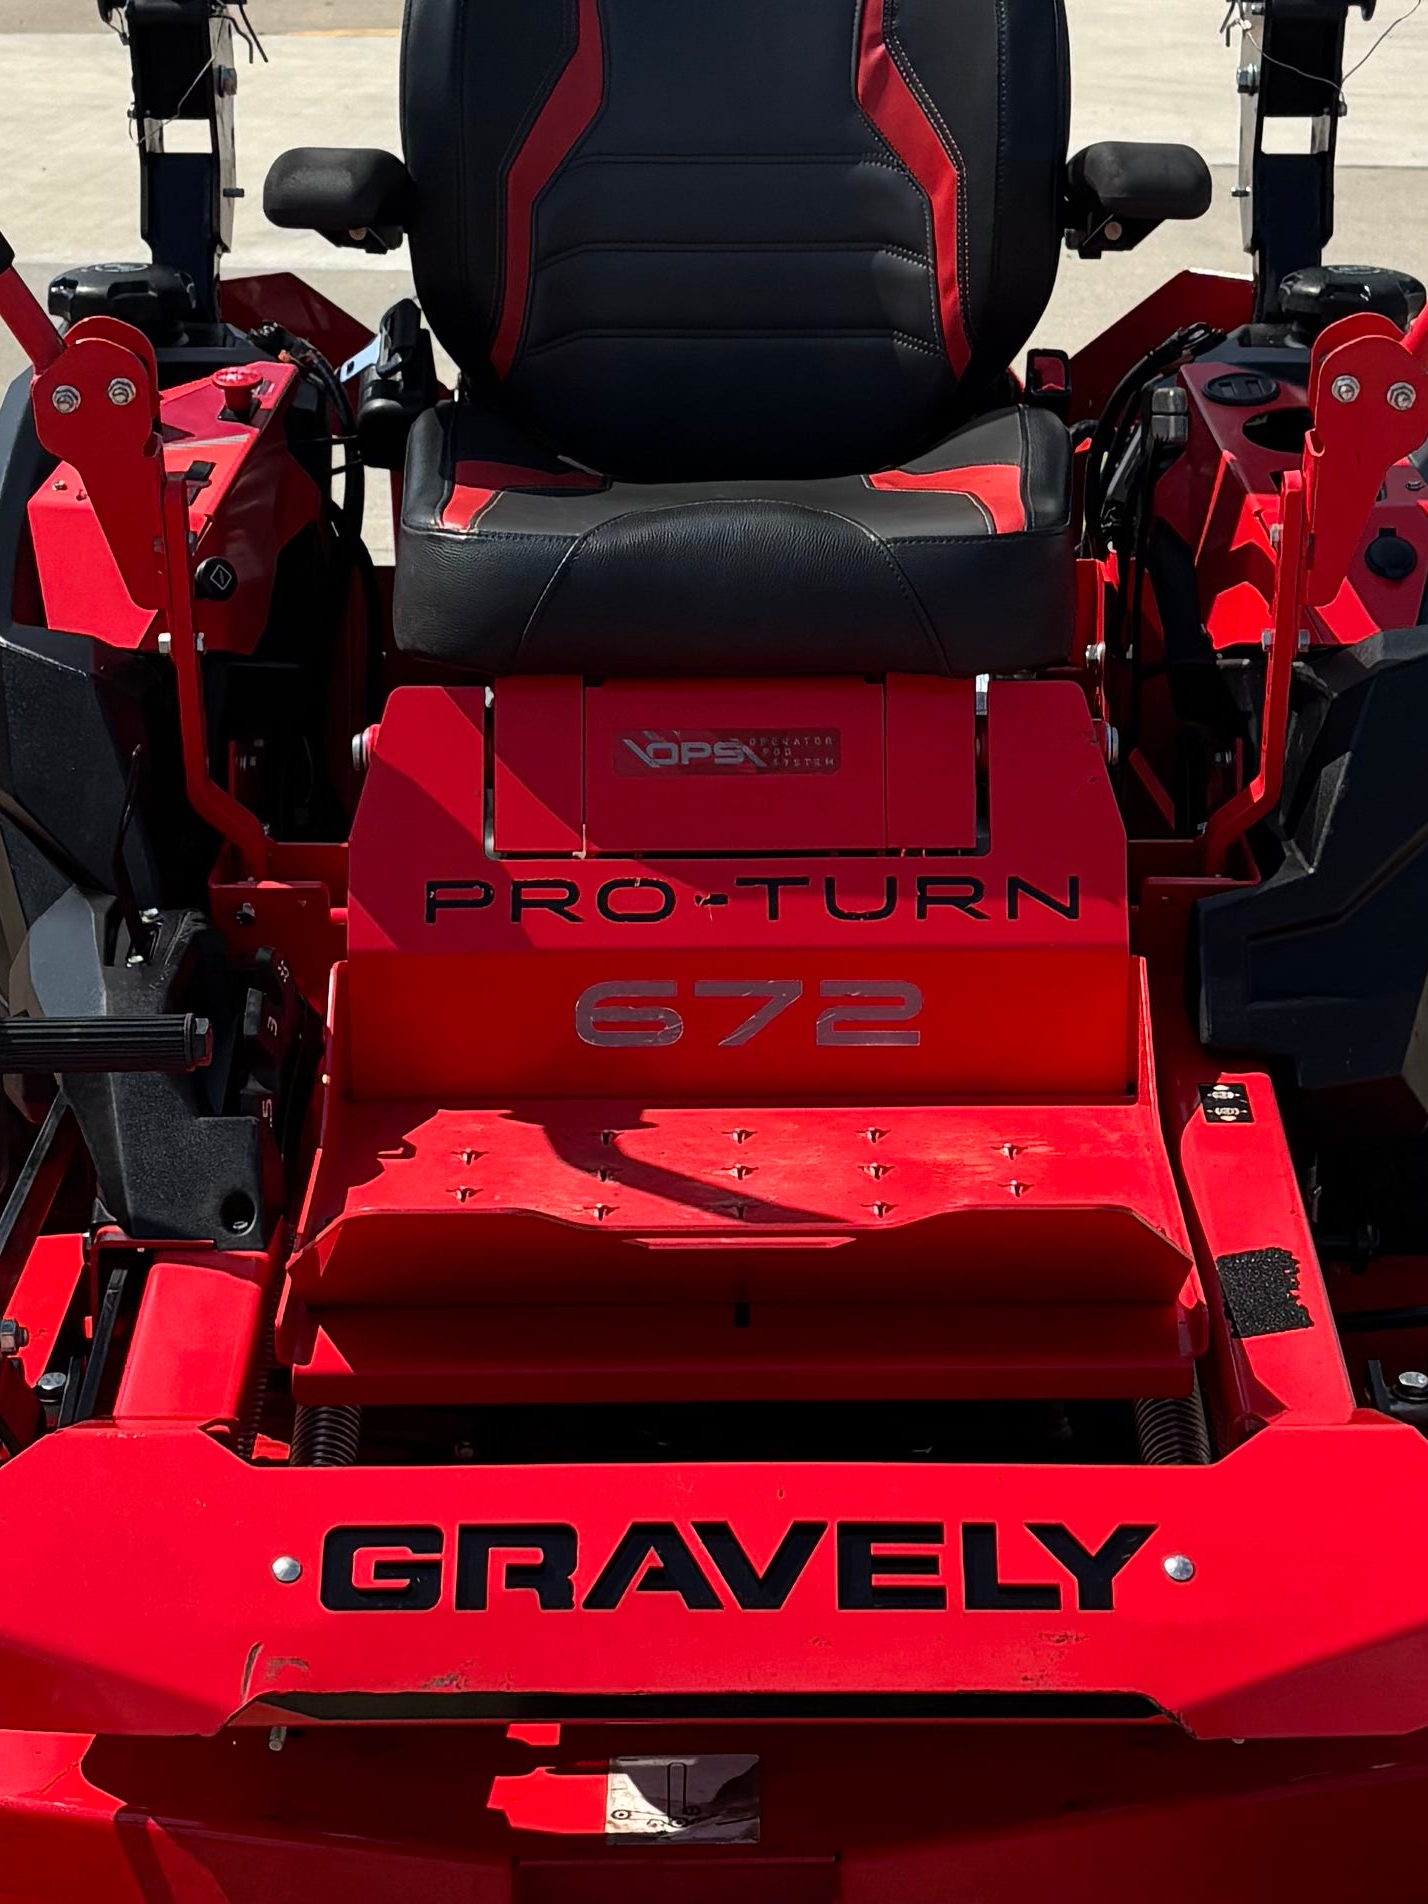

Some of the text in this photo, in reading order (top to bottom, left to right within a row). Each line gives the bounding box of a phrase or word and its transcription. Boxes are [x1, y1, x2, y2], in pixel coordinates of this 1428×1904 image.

[645, 741, 745, 766] OPS
[749, 736, 833, 746] OPERATOR
[425, 875, 1081, 924] PRO-TURN
[575, 979, 924, 1048] 672
[321, 1520, 1160, 1612] GRAVELY
